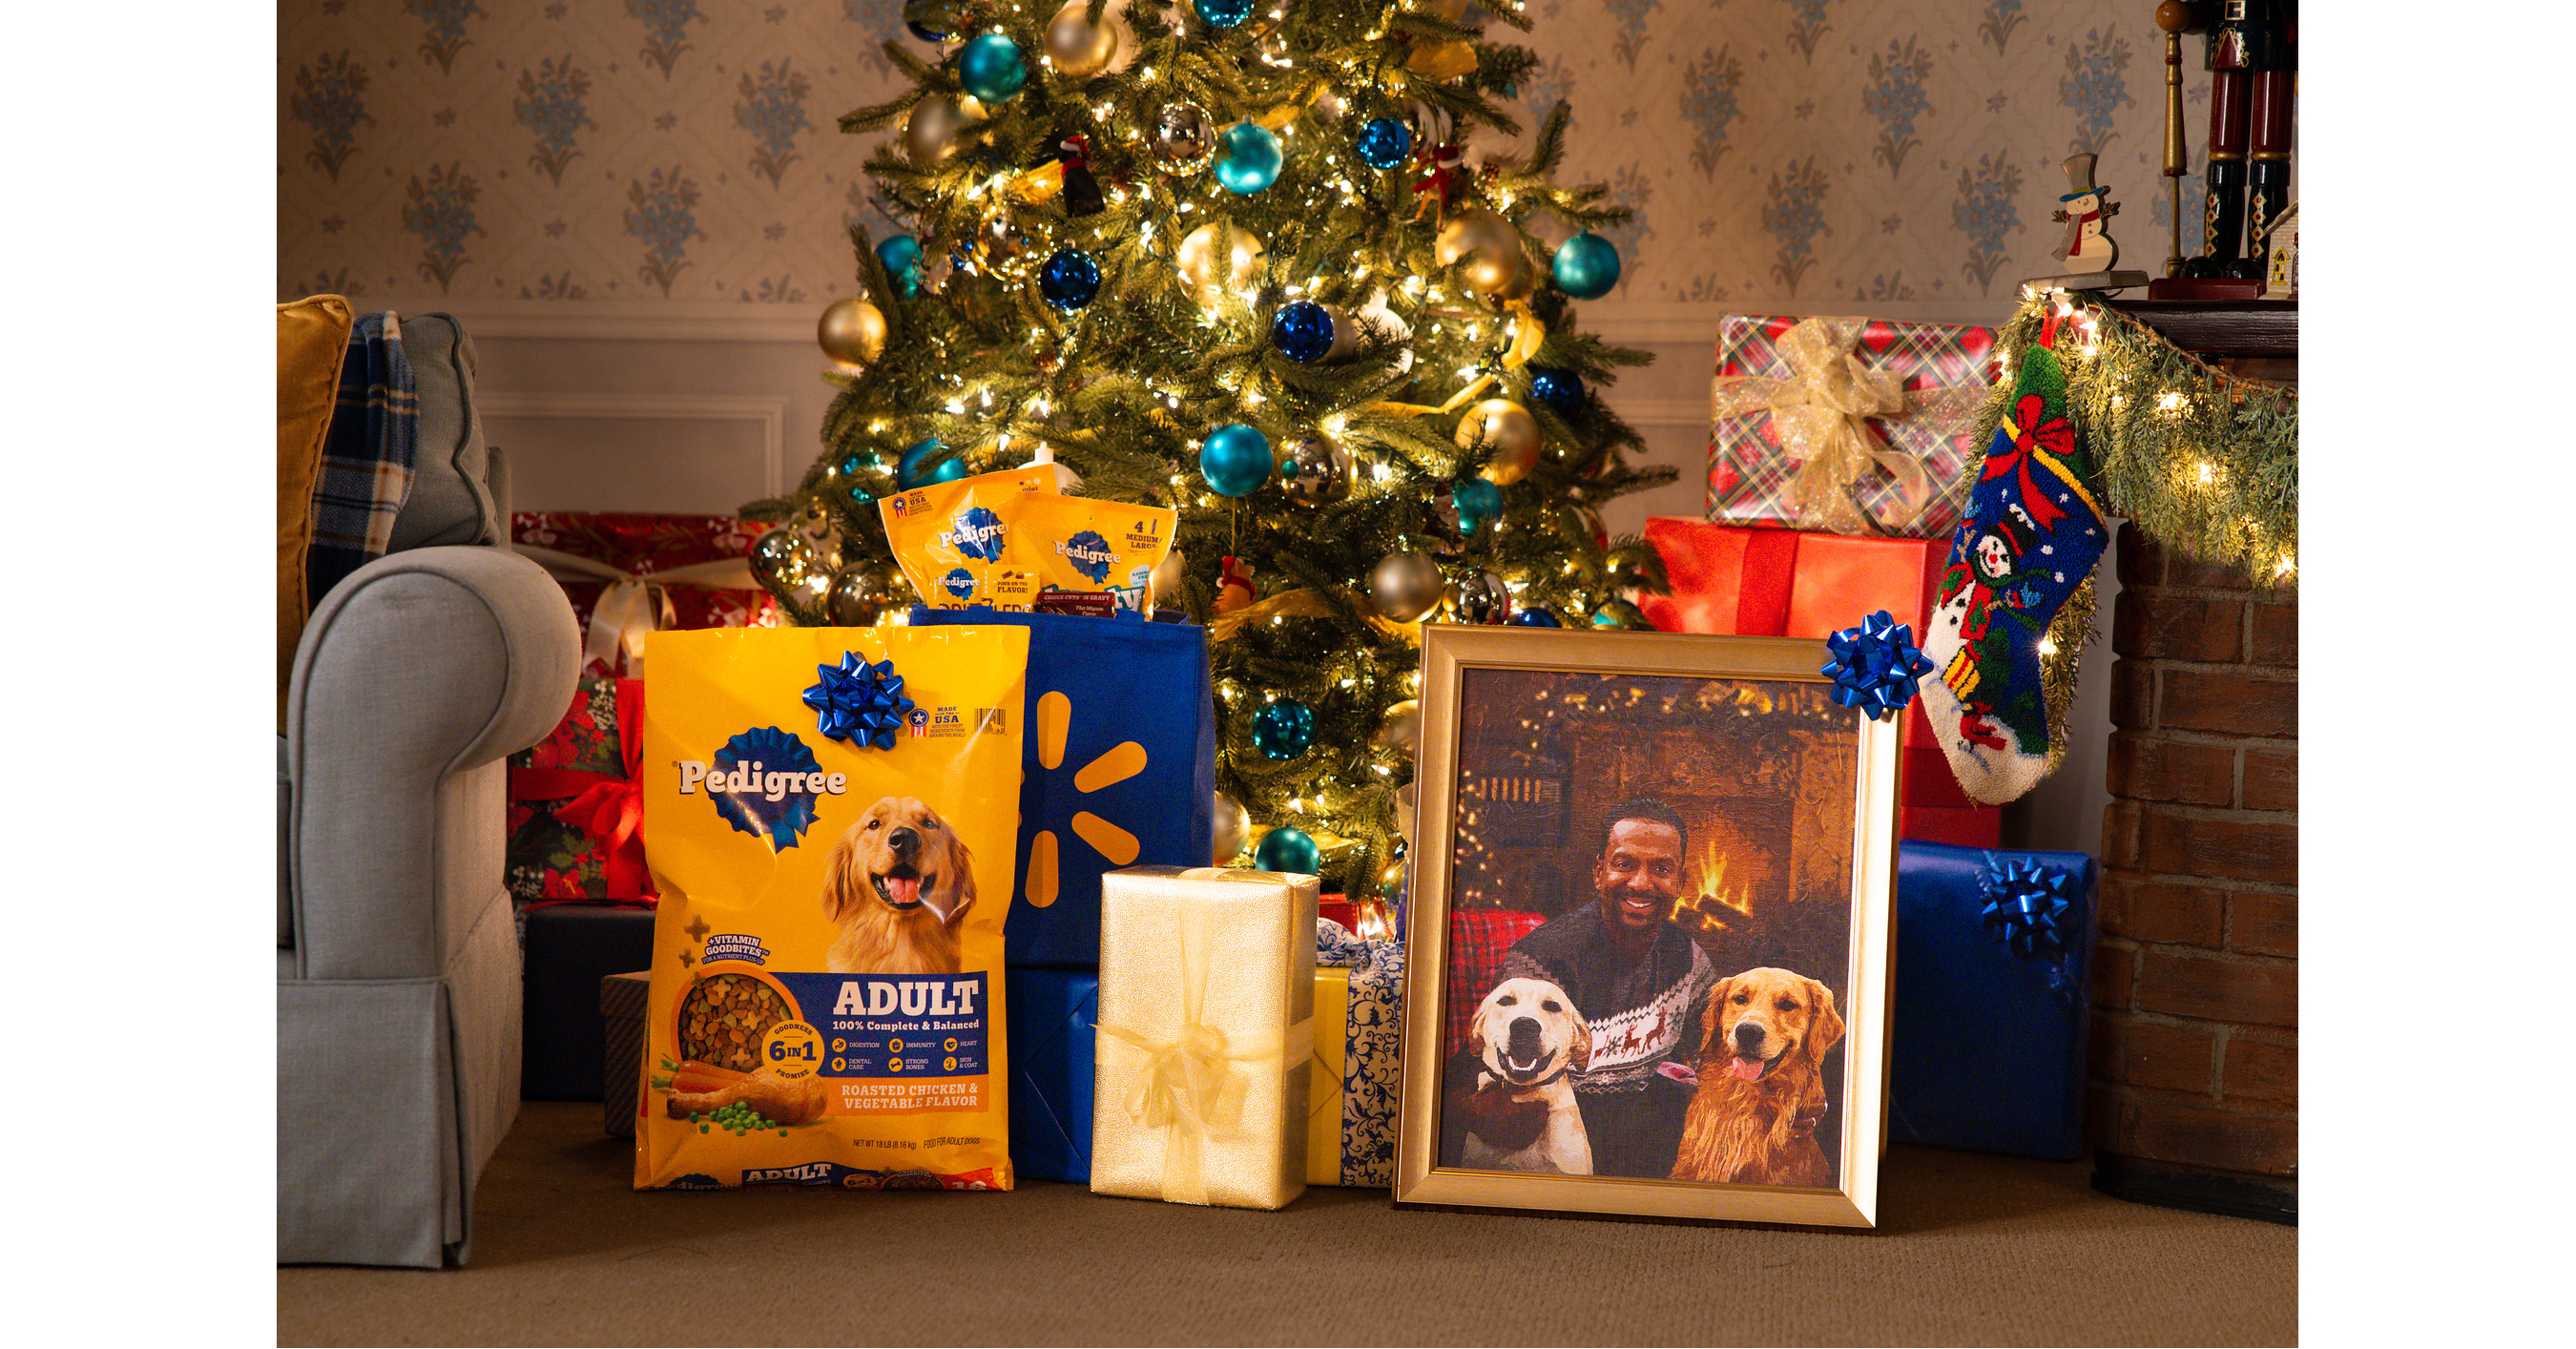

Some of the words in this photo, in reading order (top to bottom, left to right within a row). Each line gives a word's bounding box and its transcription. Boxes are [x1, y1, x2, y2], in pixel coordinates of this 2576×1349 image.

[909, 497, 926, 506] USA
[1133, 521, 1143, 532] 4
[1054, 541, 1121, 564] Pedigree
[937, 576, 980, 589] Pedigree
[935, 715, 959, 724] USA
[679, 760, 847, 802] Pedigree
[833, 980, 979, 1016] ADULT
[774, 1023, 813, 1035] GOODNESS
[833, 1021, 864, 1030] 100%
[867, 1021, 919, 1032] Complete
[922, 1021, 930, 1030] &
[933, 1019, 979, 1030] Balanced
[776, 1069, 810, 1079] PROMISE
[841, 1085, 905, 1096] ROASTED
[908, 1084, 966, 1095] CHICKEN
[968, 1083, 978, 1093] &
[844, 1098, 923, 1109] VEGETABLE
[925, 1096, 978, 1107] FLAVOR
[907, 1141, 917, 1151] kg)
[924, 1138, 937, 1149] FOOD
[937, 1137, 946, 1147] FOR
[946, 1136, 965, 1146] ADULT
[746, 1163, 832, 1182] ADULT
